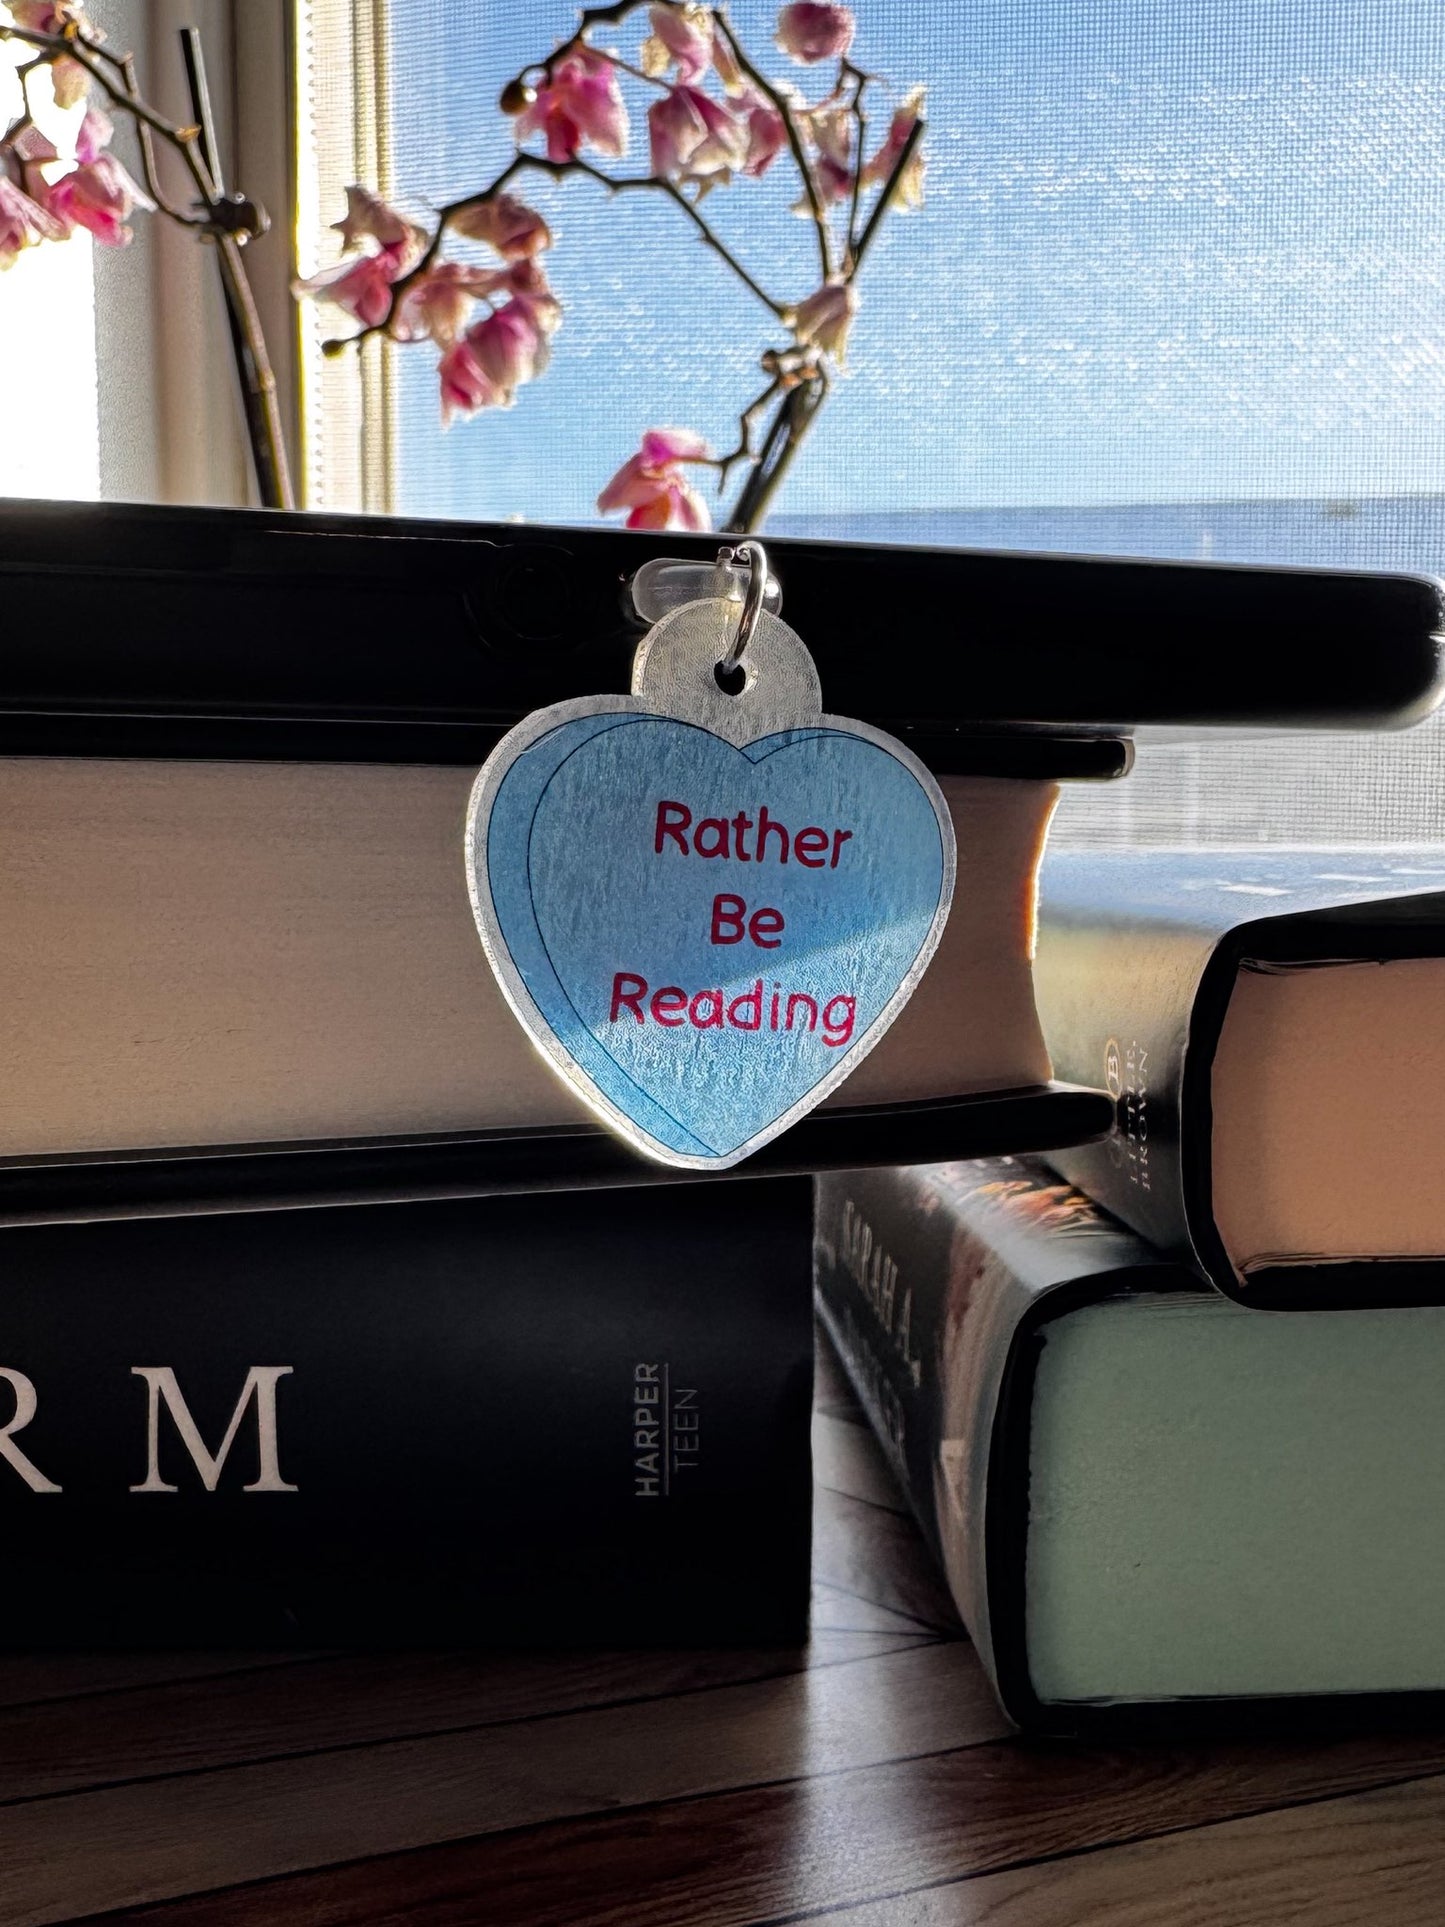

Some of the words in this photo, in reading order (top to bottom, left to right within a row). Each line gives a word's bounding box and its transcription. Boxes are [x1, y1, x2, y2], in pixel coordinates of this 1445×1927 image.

[655, 801, 853, 869] Rather
[711, 893, 785, 949] Be
[609, 972, 857, 1047] Reading
[634, 1362, 660, 1497] HARPER
[673, 1388, 699, 1473] TEEN
